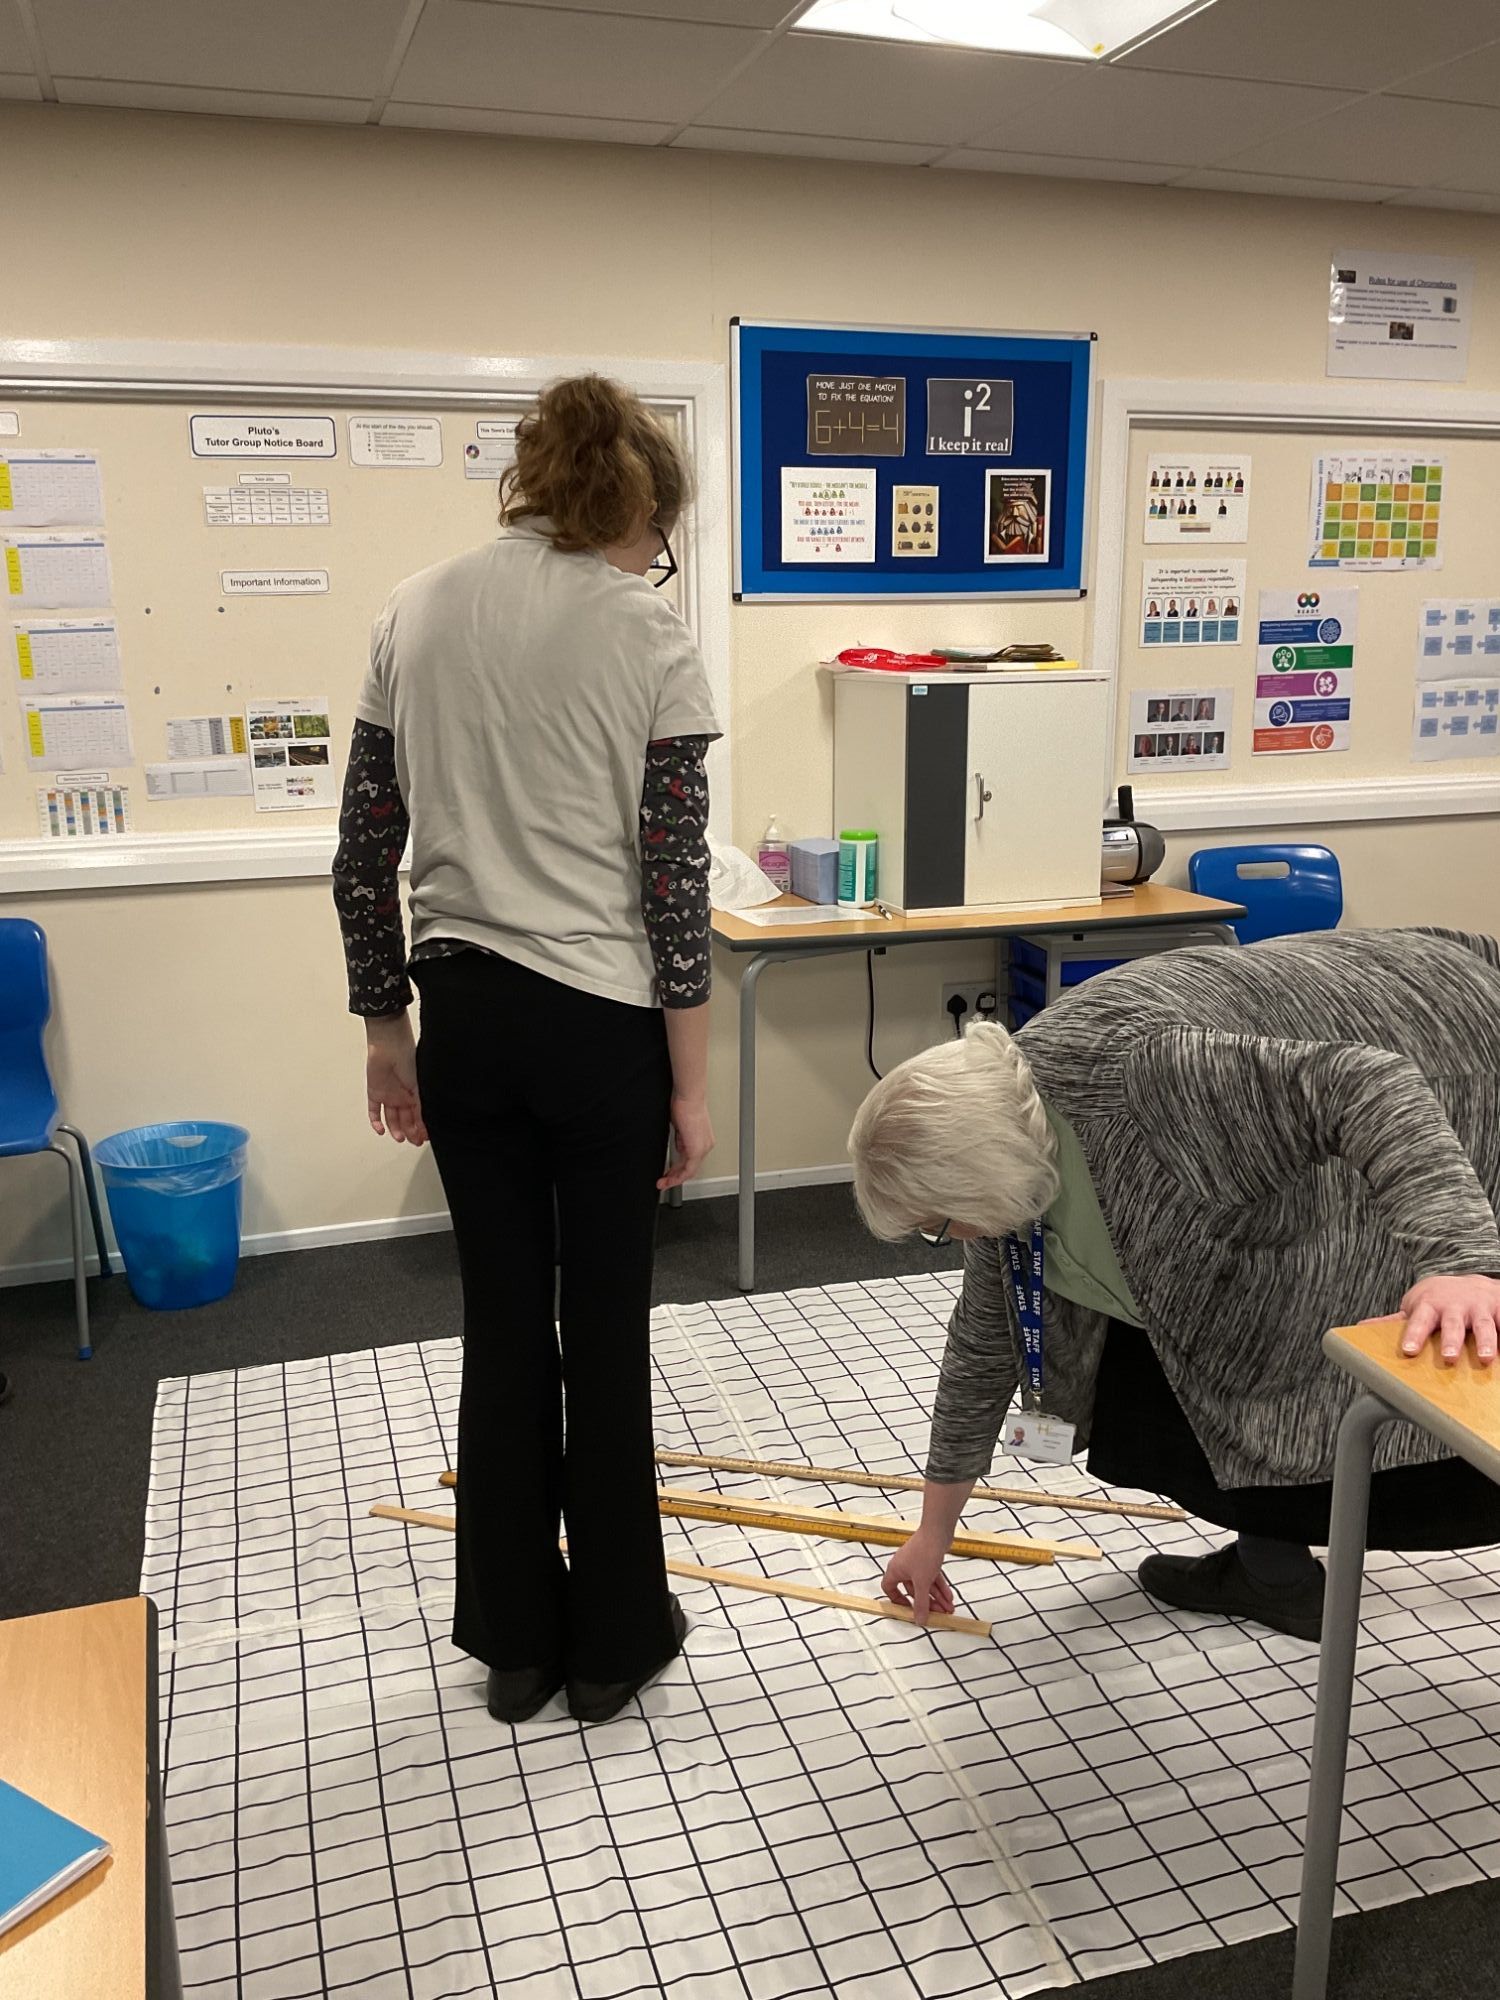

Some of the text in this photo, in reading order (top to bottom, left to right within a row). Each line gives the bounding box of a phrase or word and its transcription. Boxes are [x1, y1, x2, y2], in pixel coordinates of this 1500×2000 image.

[1369, 276, 1386, 286] Rules
[815, 381, 897, 392] MOVE JUST ONE MATCH
[817, 392, 894, 403] TO FIX THE EQUATION!
[247, 426, 280, 436] Pluto's
[204, 437, 324, 448] Tutor Group Notice Board
[929, 436, 1009, 454] I keep it real
[230, 577, 321, 588] Important Information
[1009, 1244, 1020, 1271] STAFF
[1033, 1251, 1041, 1277] STAFF
[1015, 1284, 1027, 1311] STAFF
[1032, 1290, 1041, 1316] STAFF
[1032, 1328, 1040, 1353] STAFF
